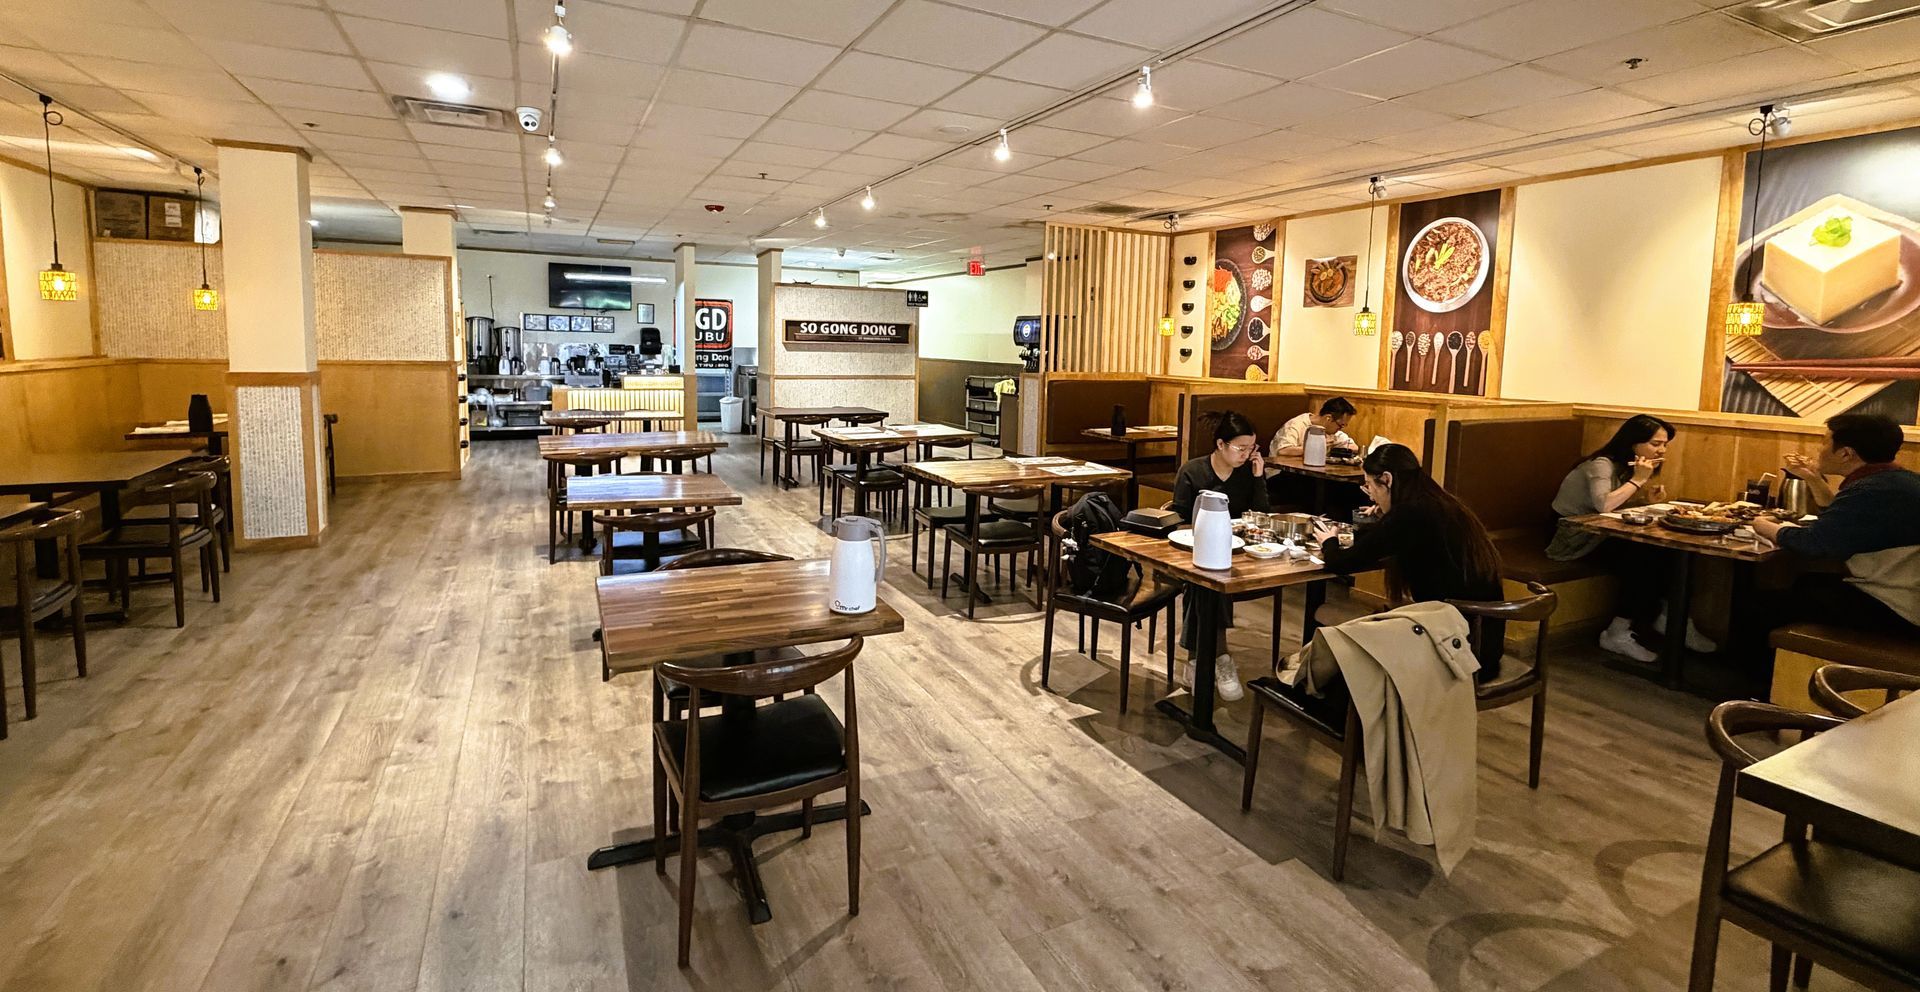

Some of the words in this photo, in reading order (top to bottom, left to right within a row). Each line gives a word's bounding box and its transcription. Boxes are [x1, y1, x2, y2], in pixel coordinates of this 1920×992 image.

[969, 263, 986, 276] EXIT
[800, 322, 818, 334] SO
[820, 323, 858, 335] GONG
[861, 324, 896, 336] DONG
